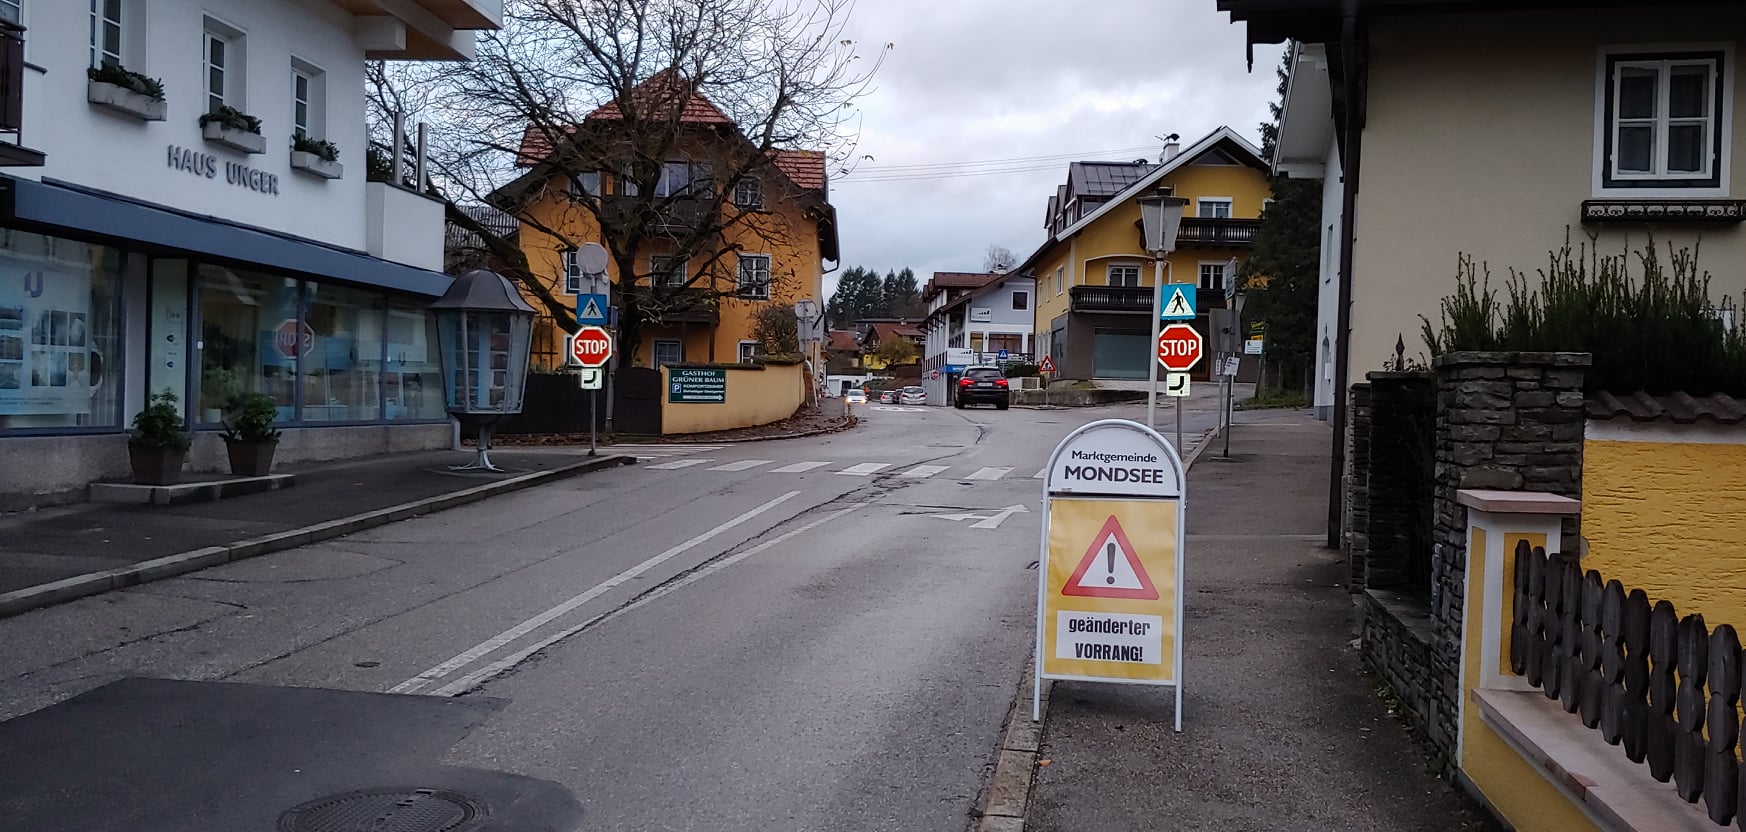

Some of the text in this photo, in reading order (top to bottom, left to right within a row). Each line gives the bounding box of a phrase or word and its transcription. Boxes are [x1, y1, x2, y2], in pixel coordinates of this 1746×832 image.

[167, 144, 279, 196] HAUS UNGER
[576, 340, 608, 355] STOP
[1160, 339, 1197, 357] STOP
[1072, 450, 1157, 463] Marktgemeinde
[1064, 465, 1163, 484] MONDSEE
[1069, 617, 1151, 636] geänderter
[1075, 643, 1143, 662] VORRANG!
